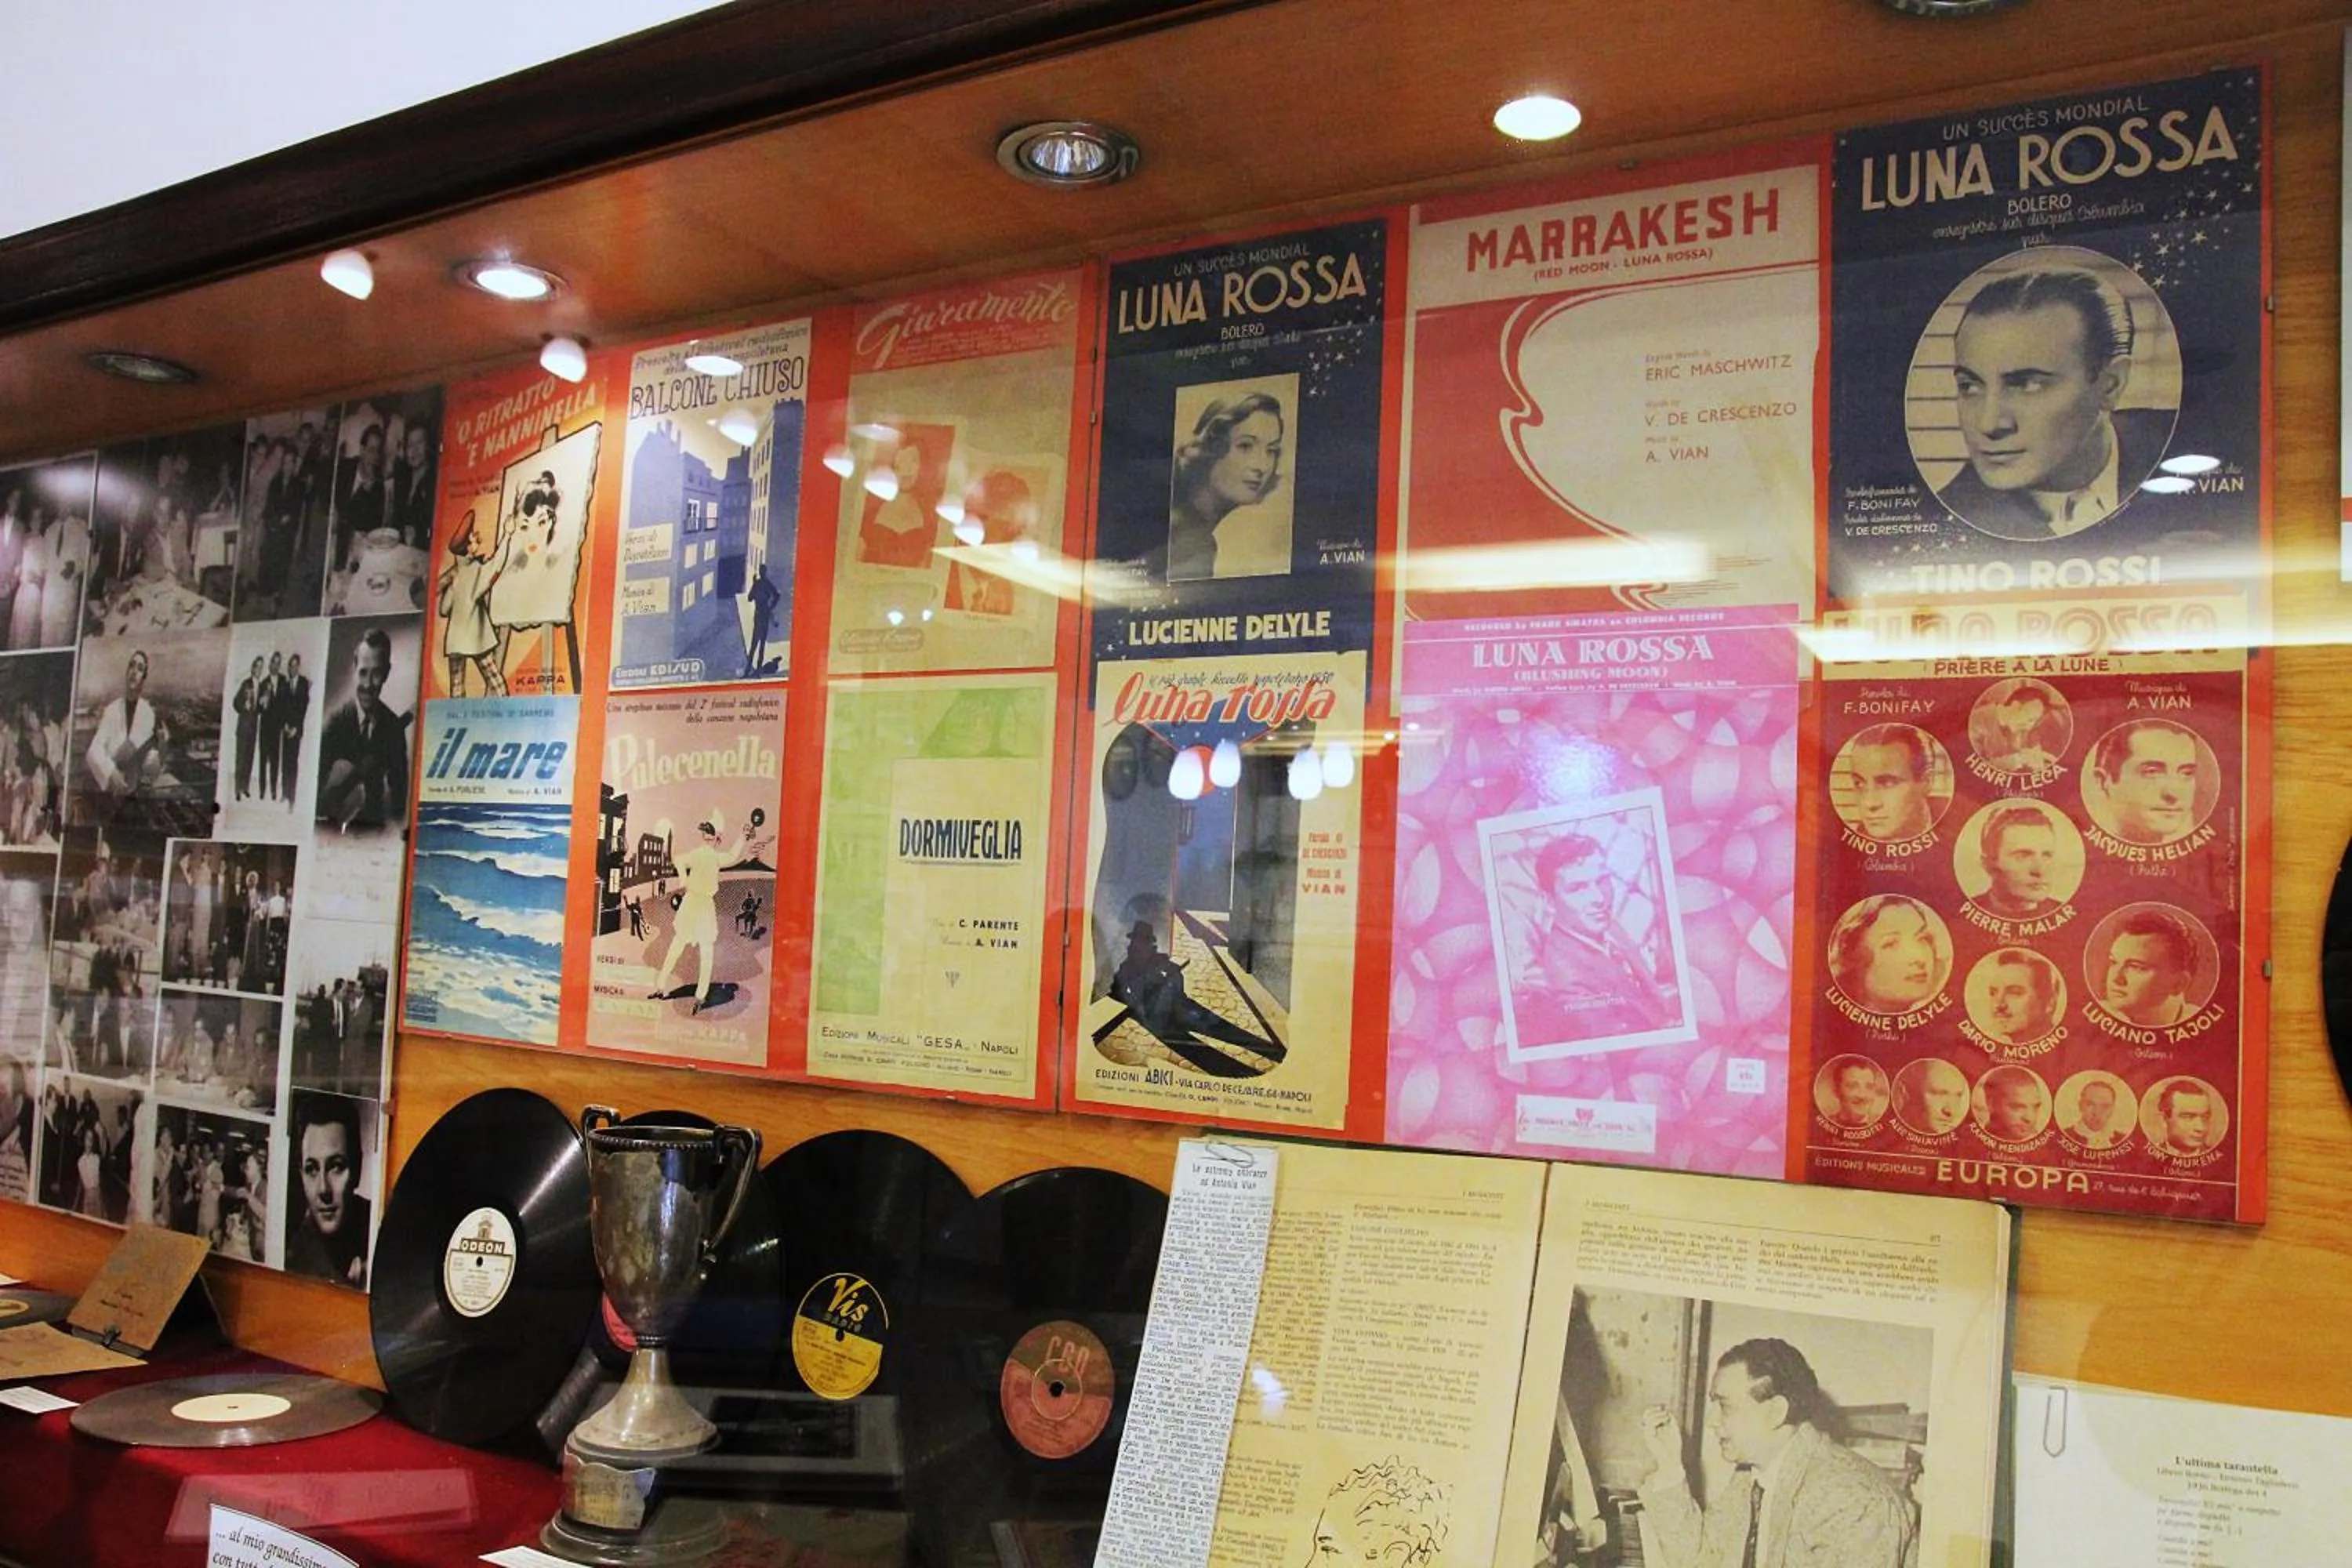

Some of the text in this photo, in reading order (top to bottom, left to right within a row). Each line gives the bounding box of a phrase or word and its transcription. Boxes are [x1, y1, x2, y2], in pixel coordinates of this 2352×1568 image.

[1944, 122, 1969, 140] UN
[2056, 95, 2148, 123] MONDIAL
[1861, 105, 2238, 212] LUNA ROSSA
[2008, 193, 2072, 216] BOLERO
[1467, 187, 1779, 273] MARRAKESH
[1174, 262, 1192, 277] UN
[1249, 243, 1311, 263] MONDIAL
[1534, 246, 1714, 283] (RED MOON LUNA ROSSA)
[1118, 252, 1367, 334] LUNA ROSSA
[1221, 322, 1265, 340] BOLERO
[1646, 354, 1793, 381] ERIC MASCHWITZ
[630, 355, 805, 421] BALCONE CHIUSO
[474, 375, 555, 437] RITRATTO
[1668, 412, 1689, 426] DE
[1697, 401, 1798, 424] CRESCENZO
[1668, 445, 1709, 462] VIAN
[2198, 476, 2245, 494] VIAN
[1871, 522, 1938, 536] CRESCENZO
[1333, 550, 1366, 564] VIAN
[1910, 555, 2162, 595] TINO ROSSI
[1128, 611, 1331, 646] LUCIENNE DELYLE
[1472, 634, 1715, 669] LUNA ROSSA
[2032, 657, 2056, 673] LA
[2060, 655, 2111, 673] LUNE
[514, 674, 566, 688] KAPPA
[2148, 694, 2193, 710] VIAN
[426, 727, 568, 780] il mare
[609, 732, 778, 794] Pulecenella
[1965, 753, 2013, 789] HENRI
[899, 818, 1022, 861] DORMIVEGLIA
[1839, 826, 1940, 858] TINO ROSSI
[2082, 823, 2217, 863] JACQUES HELIAN
[1301, 883, 1346, 895] VIAN
[972, 919, 1020, 932] PARENTE
[1958, 901, 2078, 938] PIERRE MALAR
[989, 938, 1019, 949] VIAN
[1824, 985, 1955, 1032] LUCIENNE DELYLE
[2081, 1001, 2226, 1046] LUCIANO TAJOLI
[980, 1040, 1019, 1054] NAPOLI
[1957, 1018, 2070, 1061] DARIO MORENO
[1095, 1068, 1140, 1083] EDIZIONI
[2171, 1149, 2223, 1169] MURENA
[1866, 1161, 1927, 1176] MUSICALES
[1936, 1159, 2090, 1195] EUROPA
[461, 1240, 503, 1254] ODEON
[827, 1276, 869, 1323] Vis
[2224, 1461, 2279, 1475] tarantella
[212, 1551, 234, 1567] con
[243, 1533, 265, 1552] mio
[263, 1543, 328, 1568] grandissim
